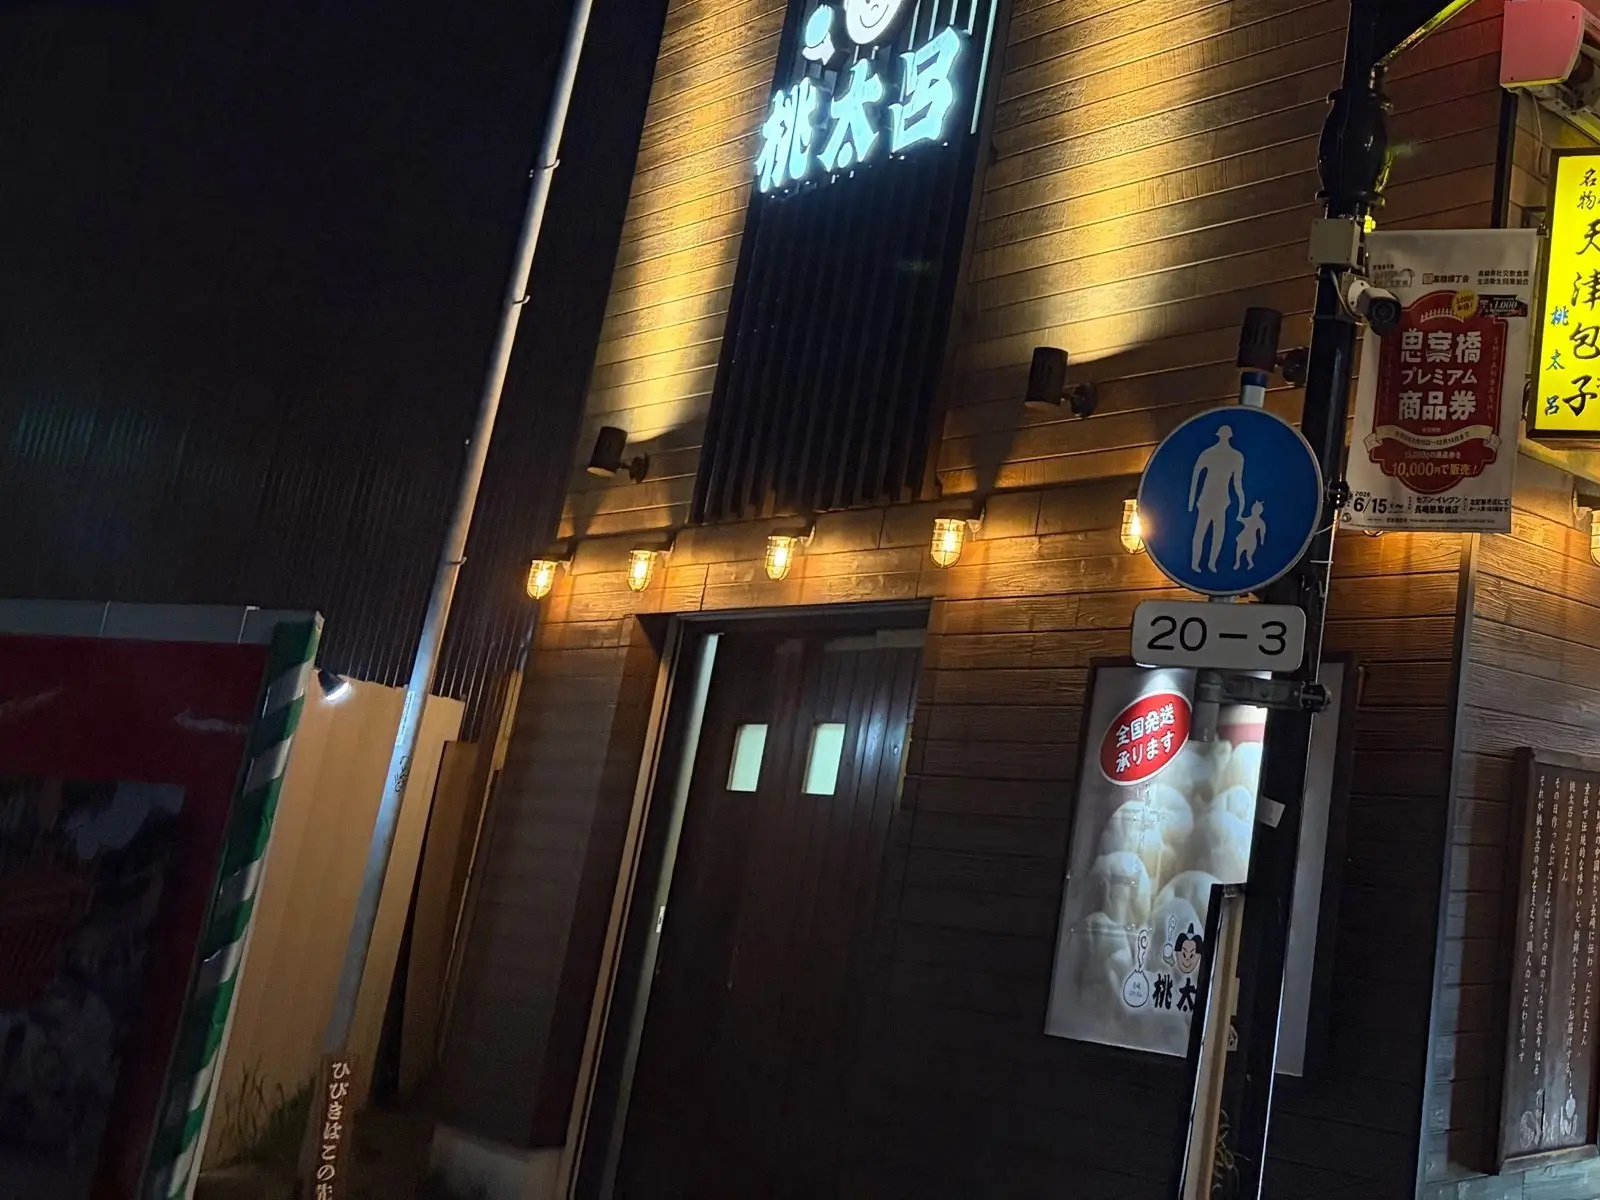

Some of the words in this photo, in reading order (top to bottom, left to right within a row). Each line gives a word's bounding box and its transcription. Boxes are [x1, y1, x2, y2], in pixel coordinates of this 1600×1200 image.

[755, 26, 961, 193] 桃太呂
[1577, 167, 1597, 209] 名物
[1400, 328, 1482, 363] 思案橋
[1544, 305, 1570, 417] 桃太呂
[1401, 366, 1478, 386] プレミアム
[1398, 390, 1477, 420] 商品券
[1353, 497, 1387, 513] 6/15
[1147, 616, 1288, 657] 20-3
[1116, 702, 1175, 748] 全国発送
[1115, 730, 1175, 773] 承ります
[1152, 973, 1198, 1012] 桃太
